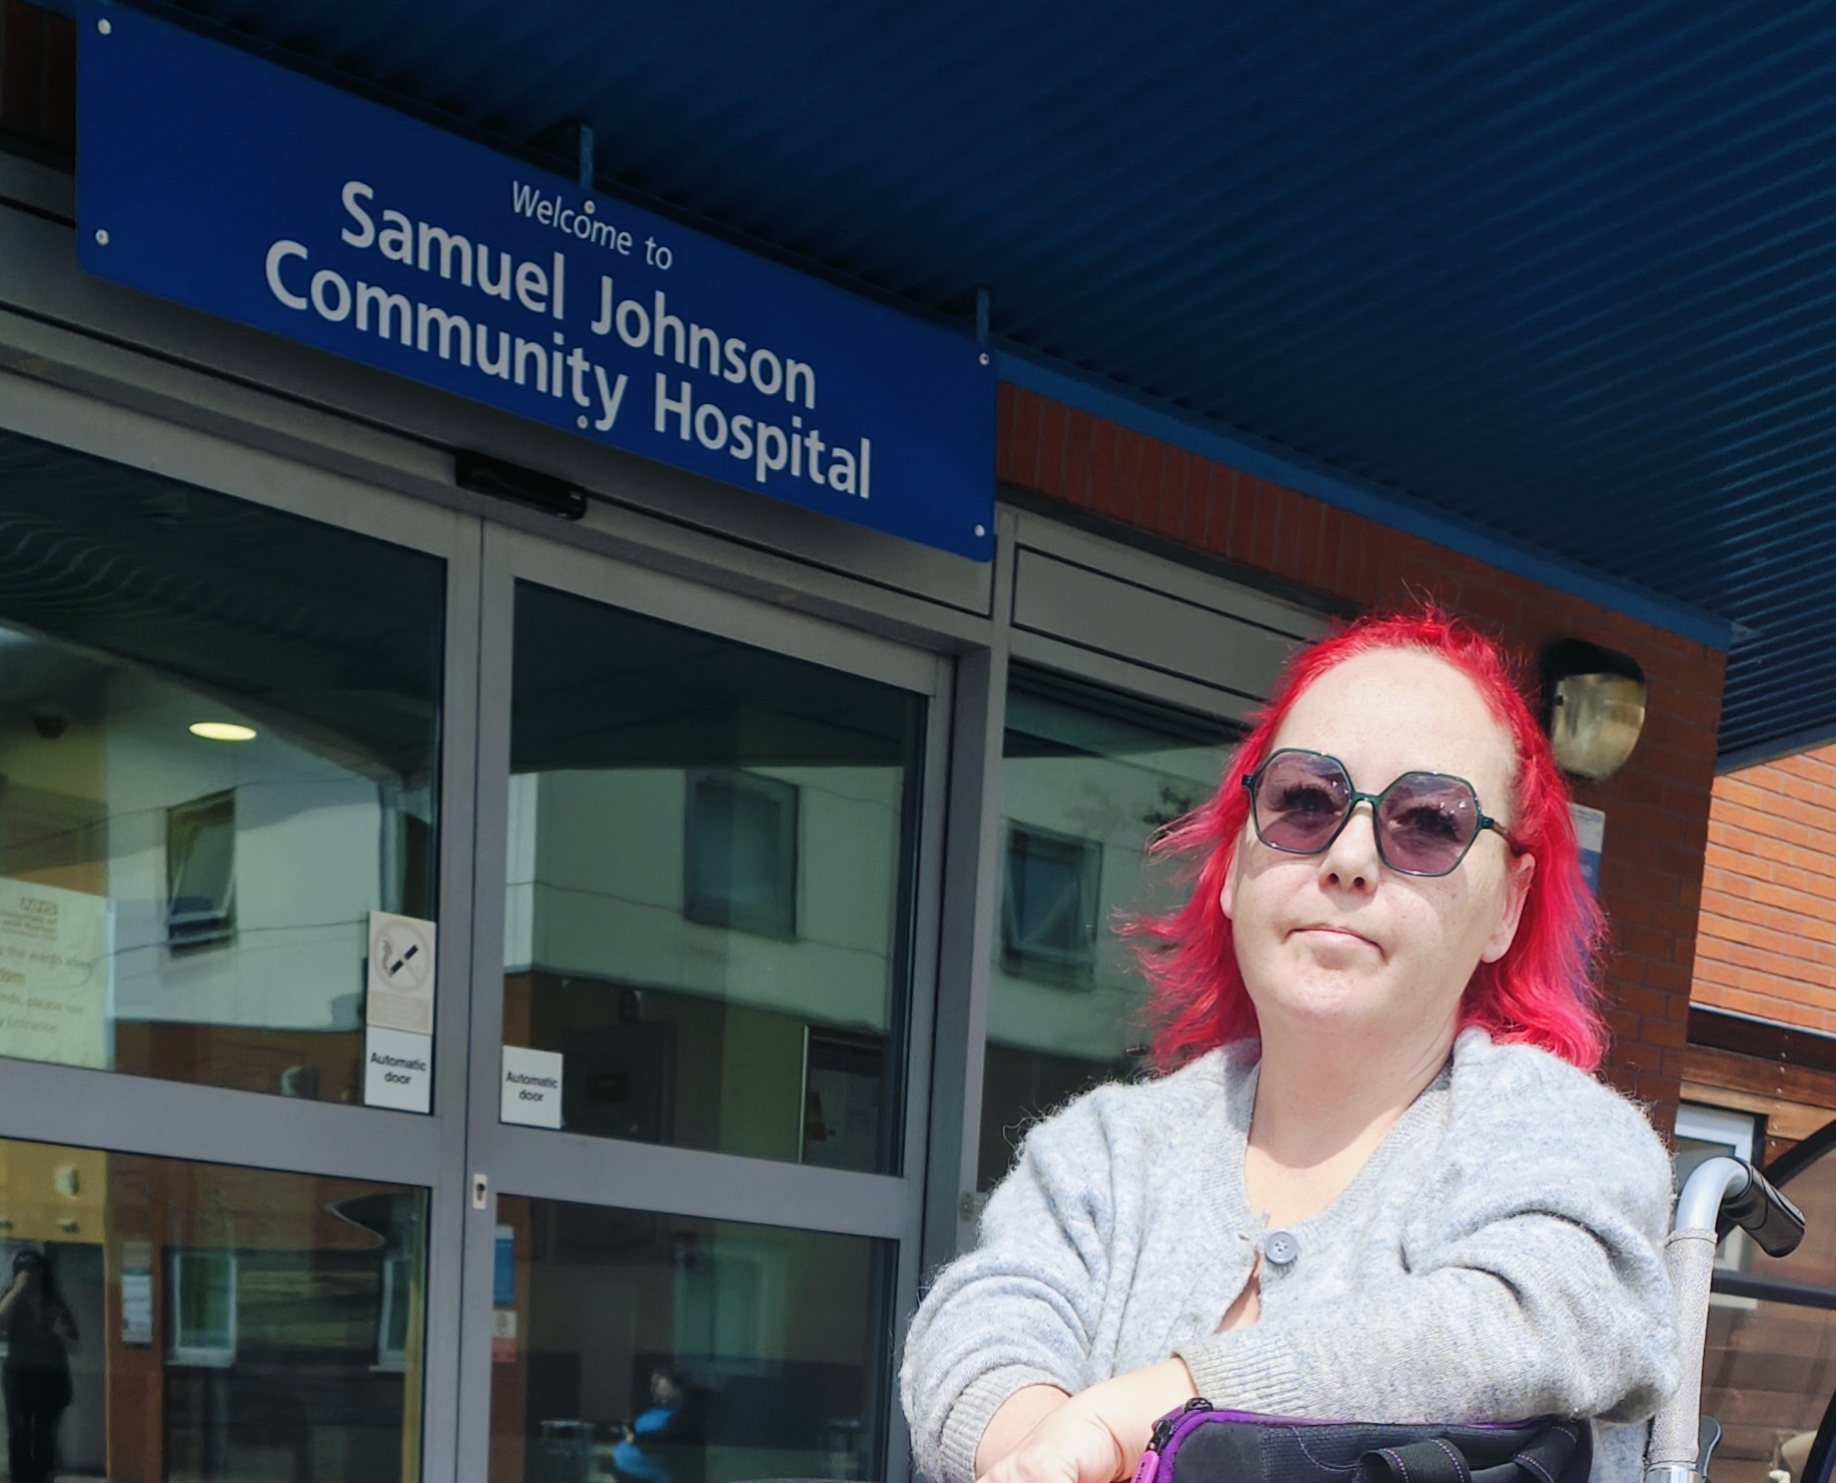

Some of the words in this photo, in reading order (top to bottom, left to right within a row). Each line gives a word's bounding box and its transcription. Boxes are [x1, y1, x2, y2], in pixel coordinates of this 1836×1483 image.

[513, 180, 633, 255] Welcome
[645, 236, 673, 270] to
[341, 180, 565, 320] Samuel
[591, 275, 815, 410] Johnson
[265, 239, 628, 432] Community
[655, 372, 870, 499] Hospital
[370, 1052, 427, 1071] Automatic
[384, 1070, 412, 1084] door
[506, 1070, 558, 1089] Automatic
[519, 1088, 544, 1103] door
